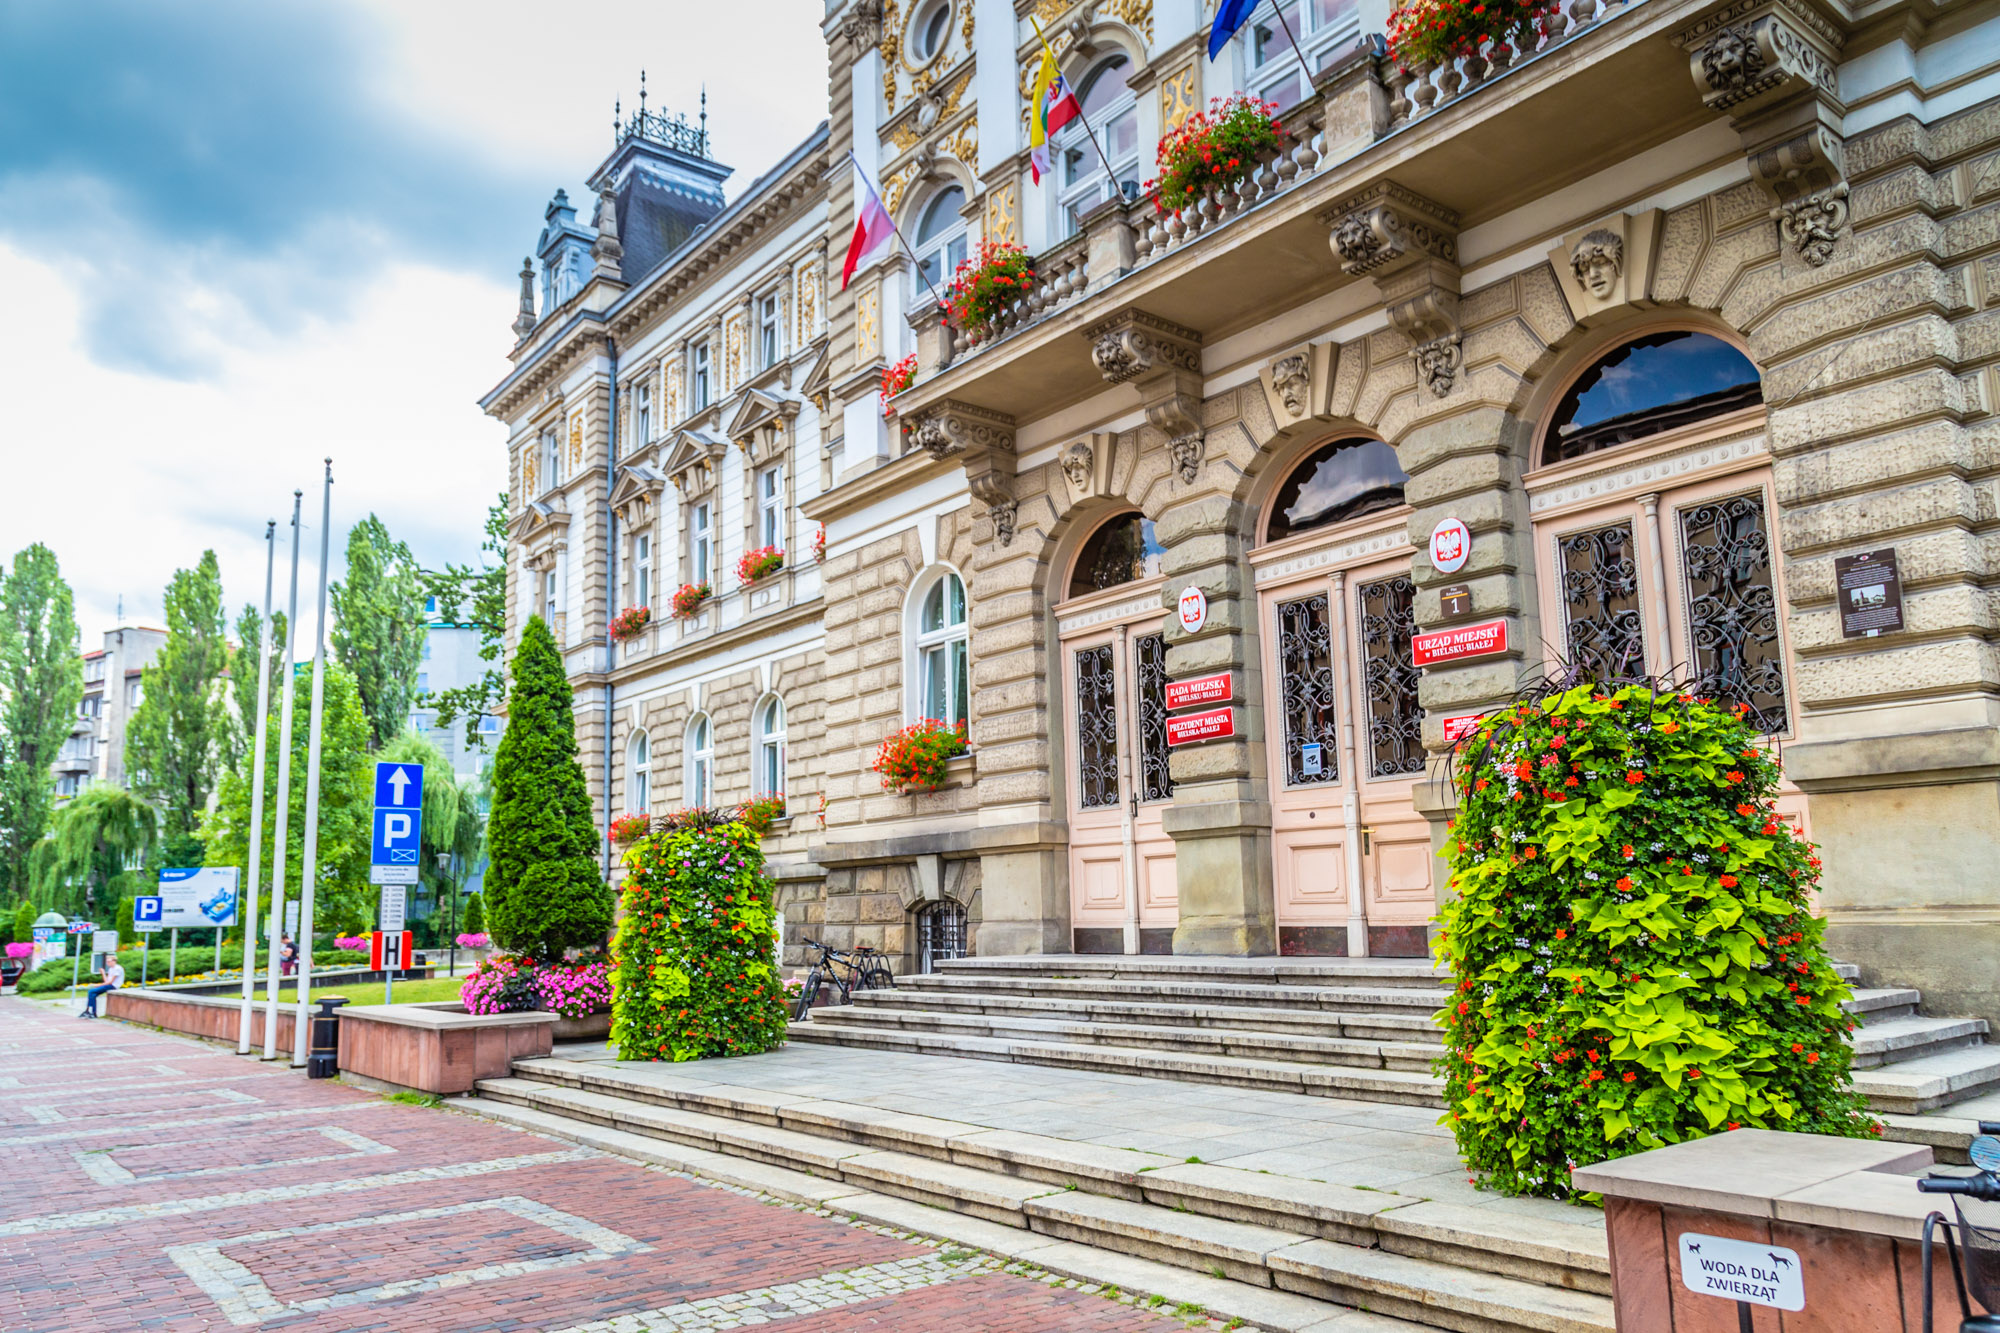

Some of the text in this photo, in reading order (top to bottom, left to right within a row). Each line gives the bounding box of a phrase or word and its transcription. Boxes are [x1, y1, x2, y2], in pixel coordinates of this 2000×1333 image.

[1451, 598, 1460, 614] 1
[1418, 627, 1498, 651] URZĄD MIEJSKI
[1432, 639, 1494, 657] BIELSKU-BIAŁEJ
[1169, 679, 1225, 697] RADA MIEJSKA
[1178, 689, 1222, 703] BIELSKU-BIAŁEJ
[1169, 714, 1229, 732] PREZYDENT MIASTA
[1176, 724, 1220, 738] BIELSKA-BIAŁEJ
[383, 813, 412, 848] P
[140, 899, 158, 919] P
[384, 936, 400, 965] H
[1700, 1258, 1780, 1284] WODA DLA
[1706, 1276, 1777, 1302] ZWIERZĄT
